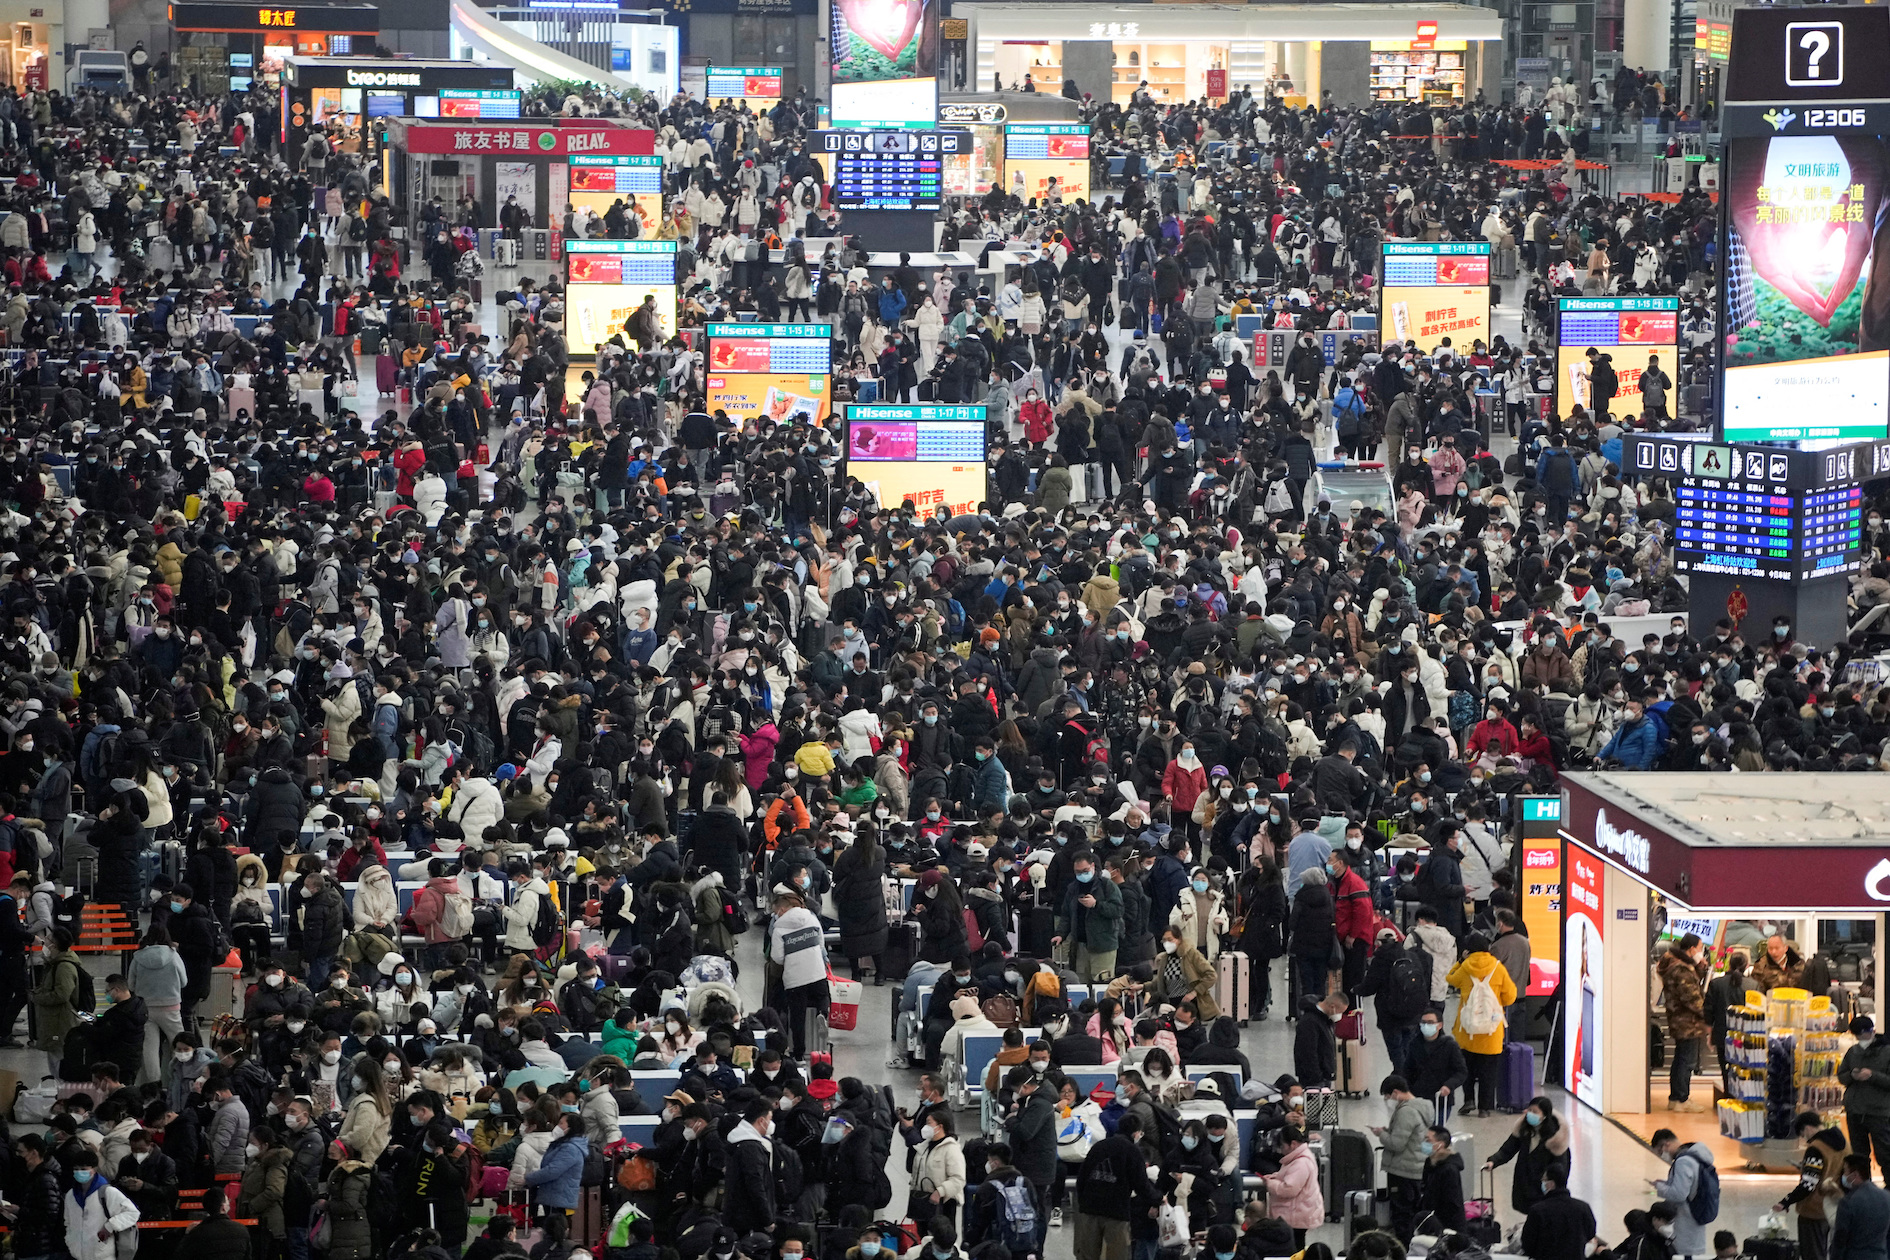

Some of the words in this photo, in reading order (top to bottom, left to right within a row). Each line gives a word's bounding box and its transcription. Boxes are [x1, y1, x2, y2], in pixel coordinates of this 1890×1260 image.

[1804, 109, 1866, 127] 12306
[454, 131, 530, 150] 旅友书屋
[1784, 162, 1840, 178] 文明旅游
[1756, 184, 1865, 203] 每个人都是一道
[1756, 202, 1864, 224] 亮丽的风景线
[1390, 245, 1433, 253] Hisense
[1567, 300, 1615, 309] Hisense
[1425, 308, 1457, 323] 刺柠吉
[715, 326, 766, 335] Hisense
[1420, 316, 1481, 337] 富含天然高维C
[856, 408, 912, 418] Hisense
[939, 408, 954, 417] 1-17
[1703, 554, 1757, 568] 上海虹桥站欢迎您
[416, 1158, 435, 1195] RUN
